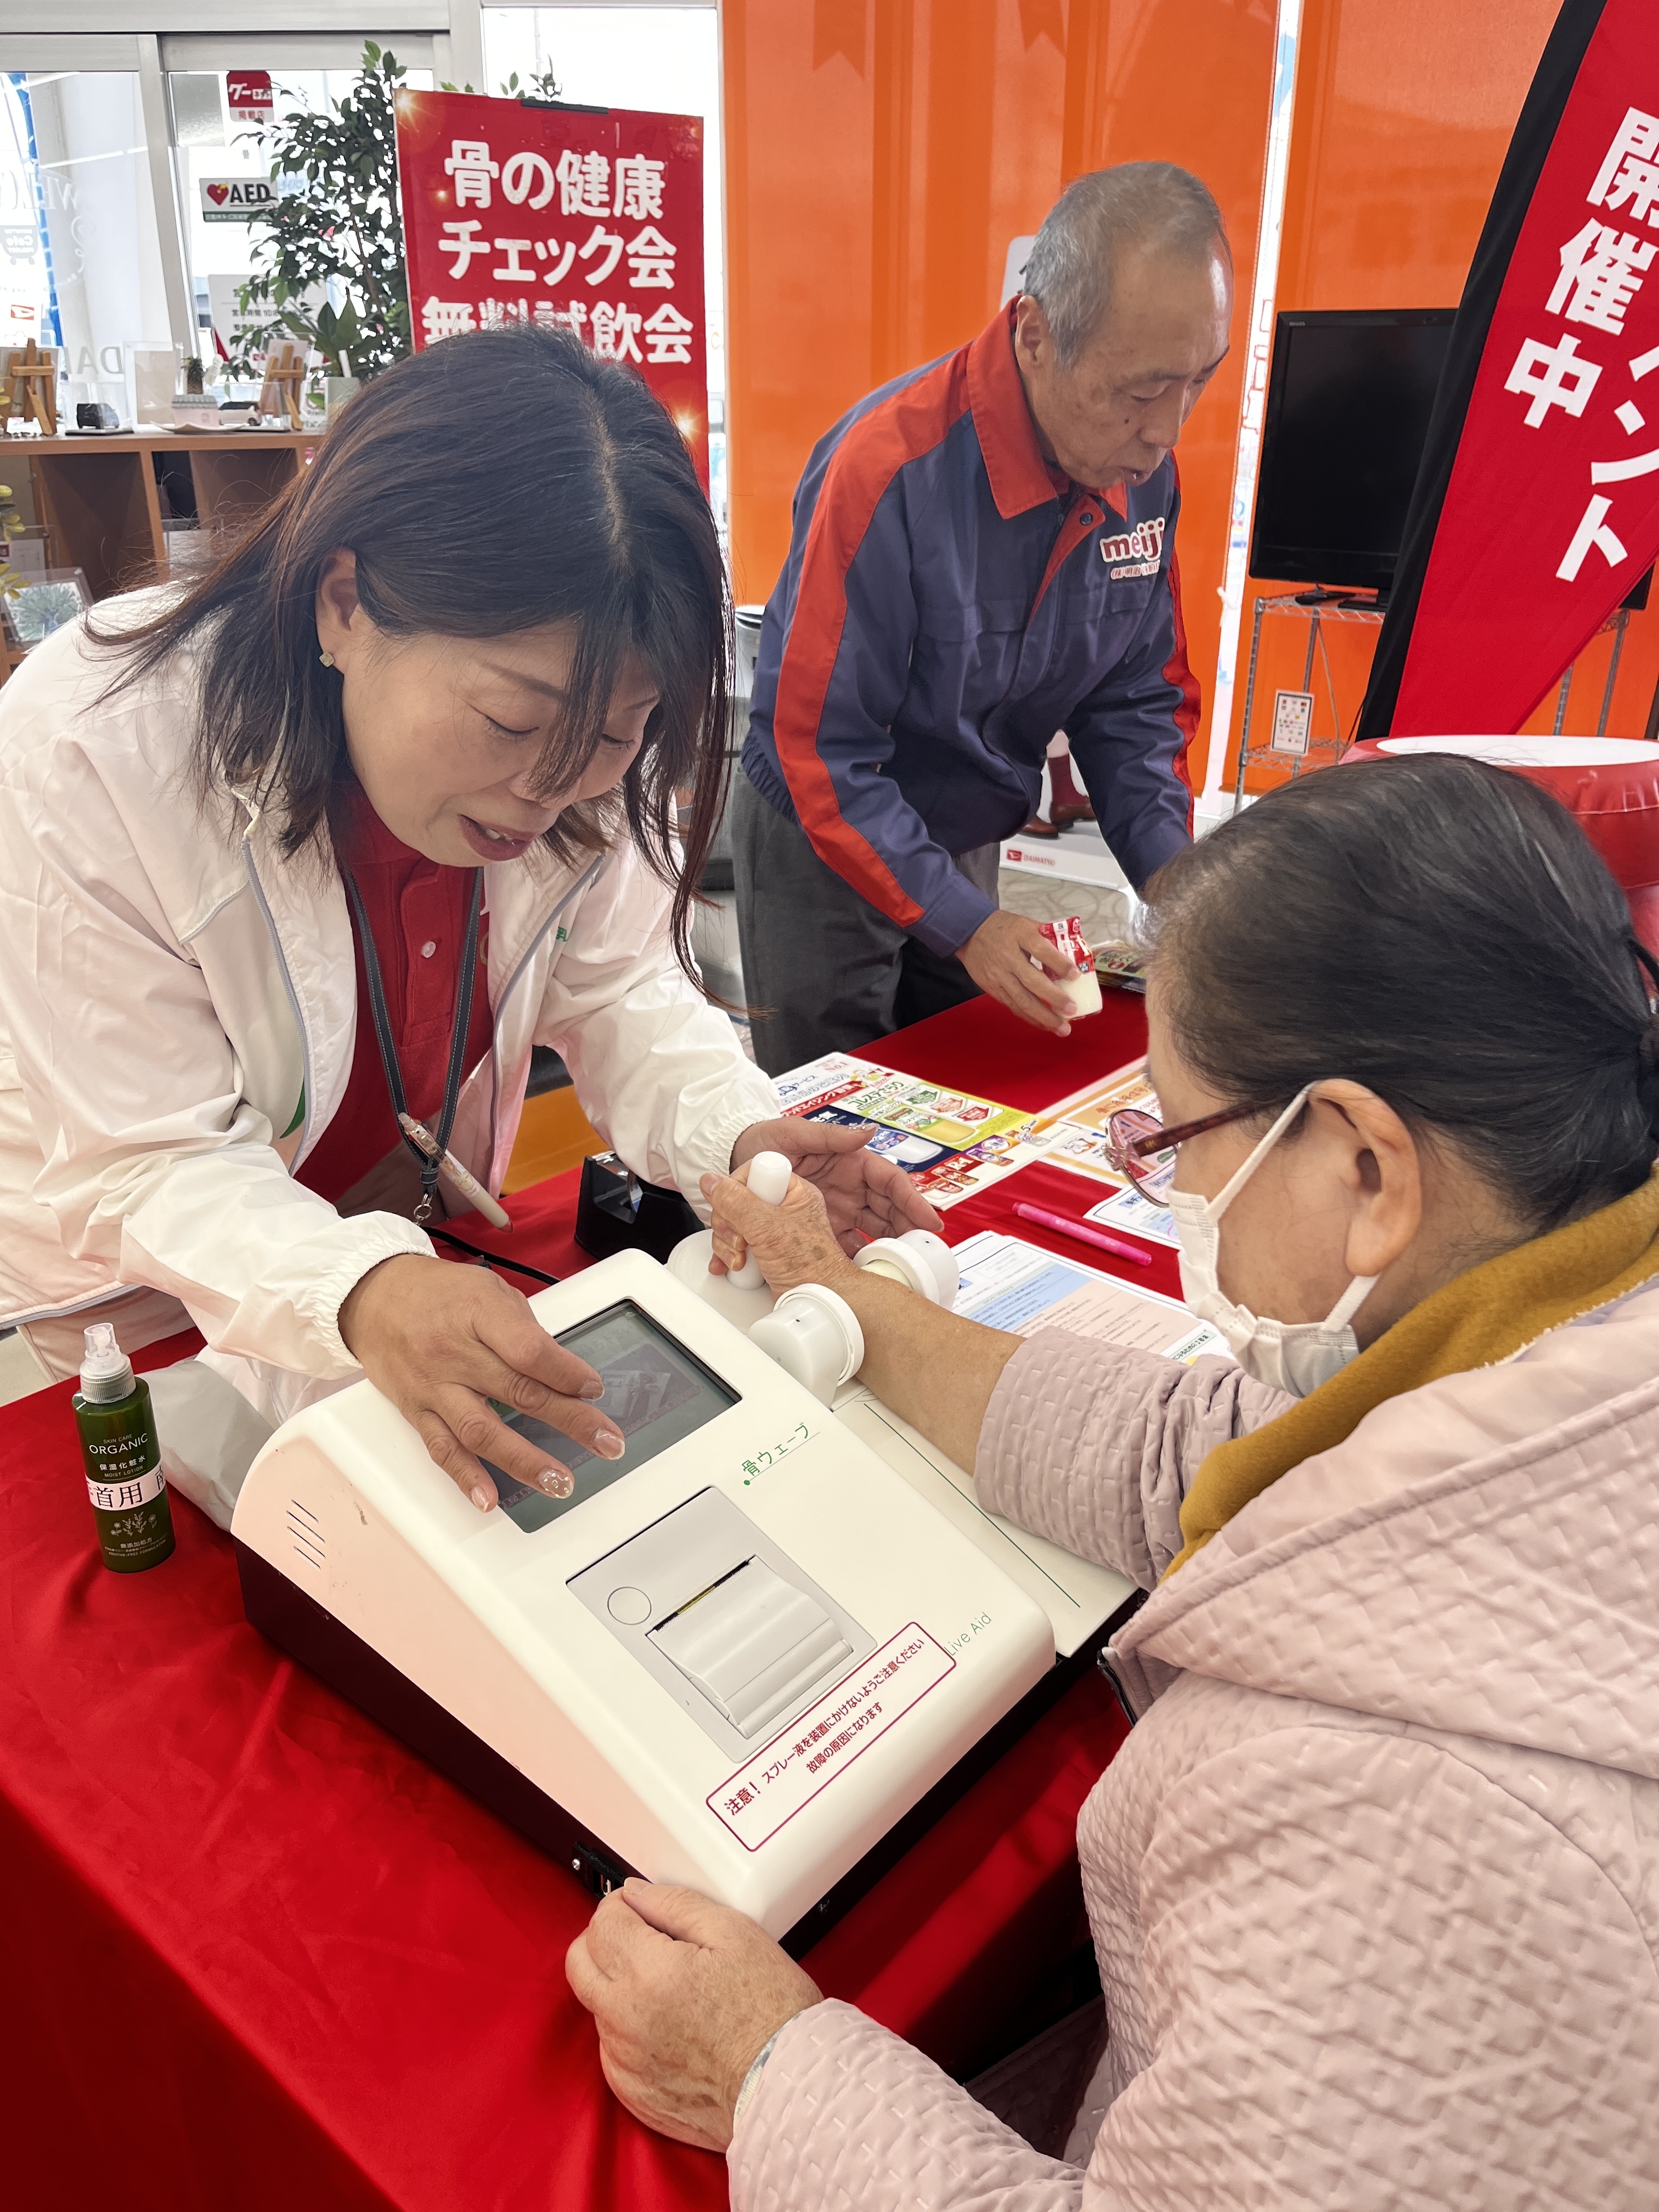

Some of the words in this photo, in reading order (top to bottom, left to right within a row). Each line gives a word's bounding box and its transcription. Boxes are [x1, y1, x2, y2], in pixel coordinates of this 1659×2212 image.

[230, 183, 270, 203] AED
[444, 139, 666, 220] 骨の健康
[438, 221, 677, 289] チェック会
[1504, 106, 1659, 430] 開催中
[89, 1432, 149, 1455] ORGANIC
[119, 1433, 133, 1442] CARE
[742, 1422, 808, 1476] 骨ウェーブ
[99, 1455, 146, 1471] 保湿化粧水
[123, 1465, 143, 1476] LOTION
[944, 1633, 970, 1656] Live
[970, 1611, 992, 1635] Aid
[724, 1781, 761, 1816] 注意！
[761, 1638, 924, 1784] スプレー液を装置にかけないようご注意ください
[806, 1701, 883, 1774] 故障の原因になります
